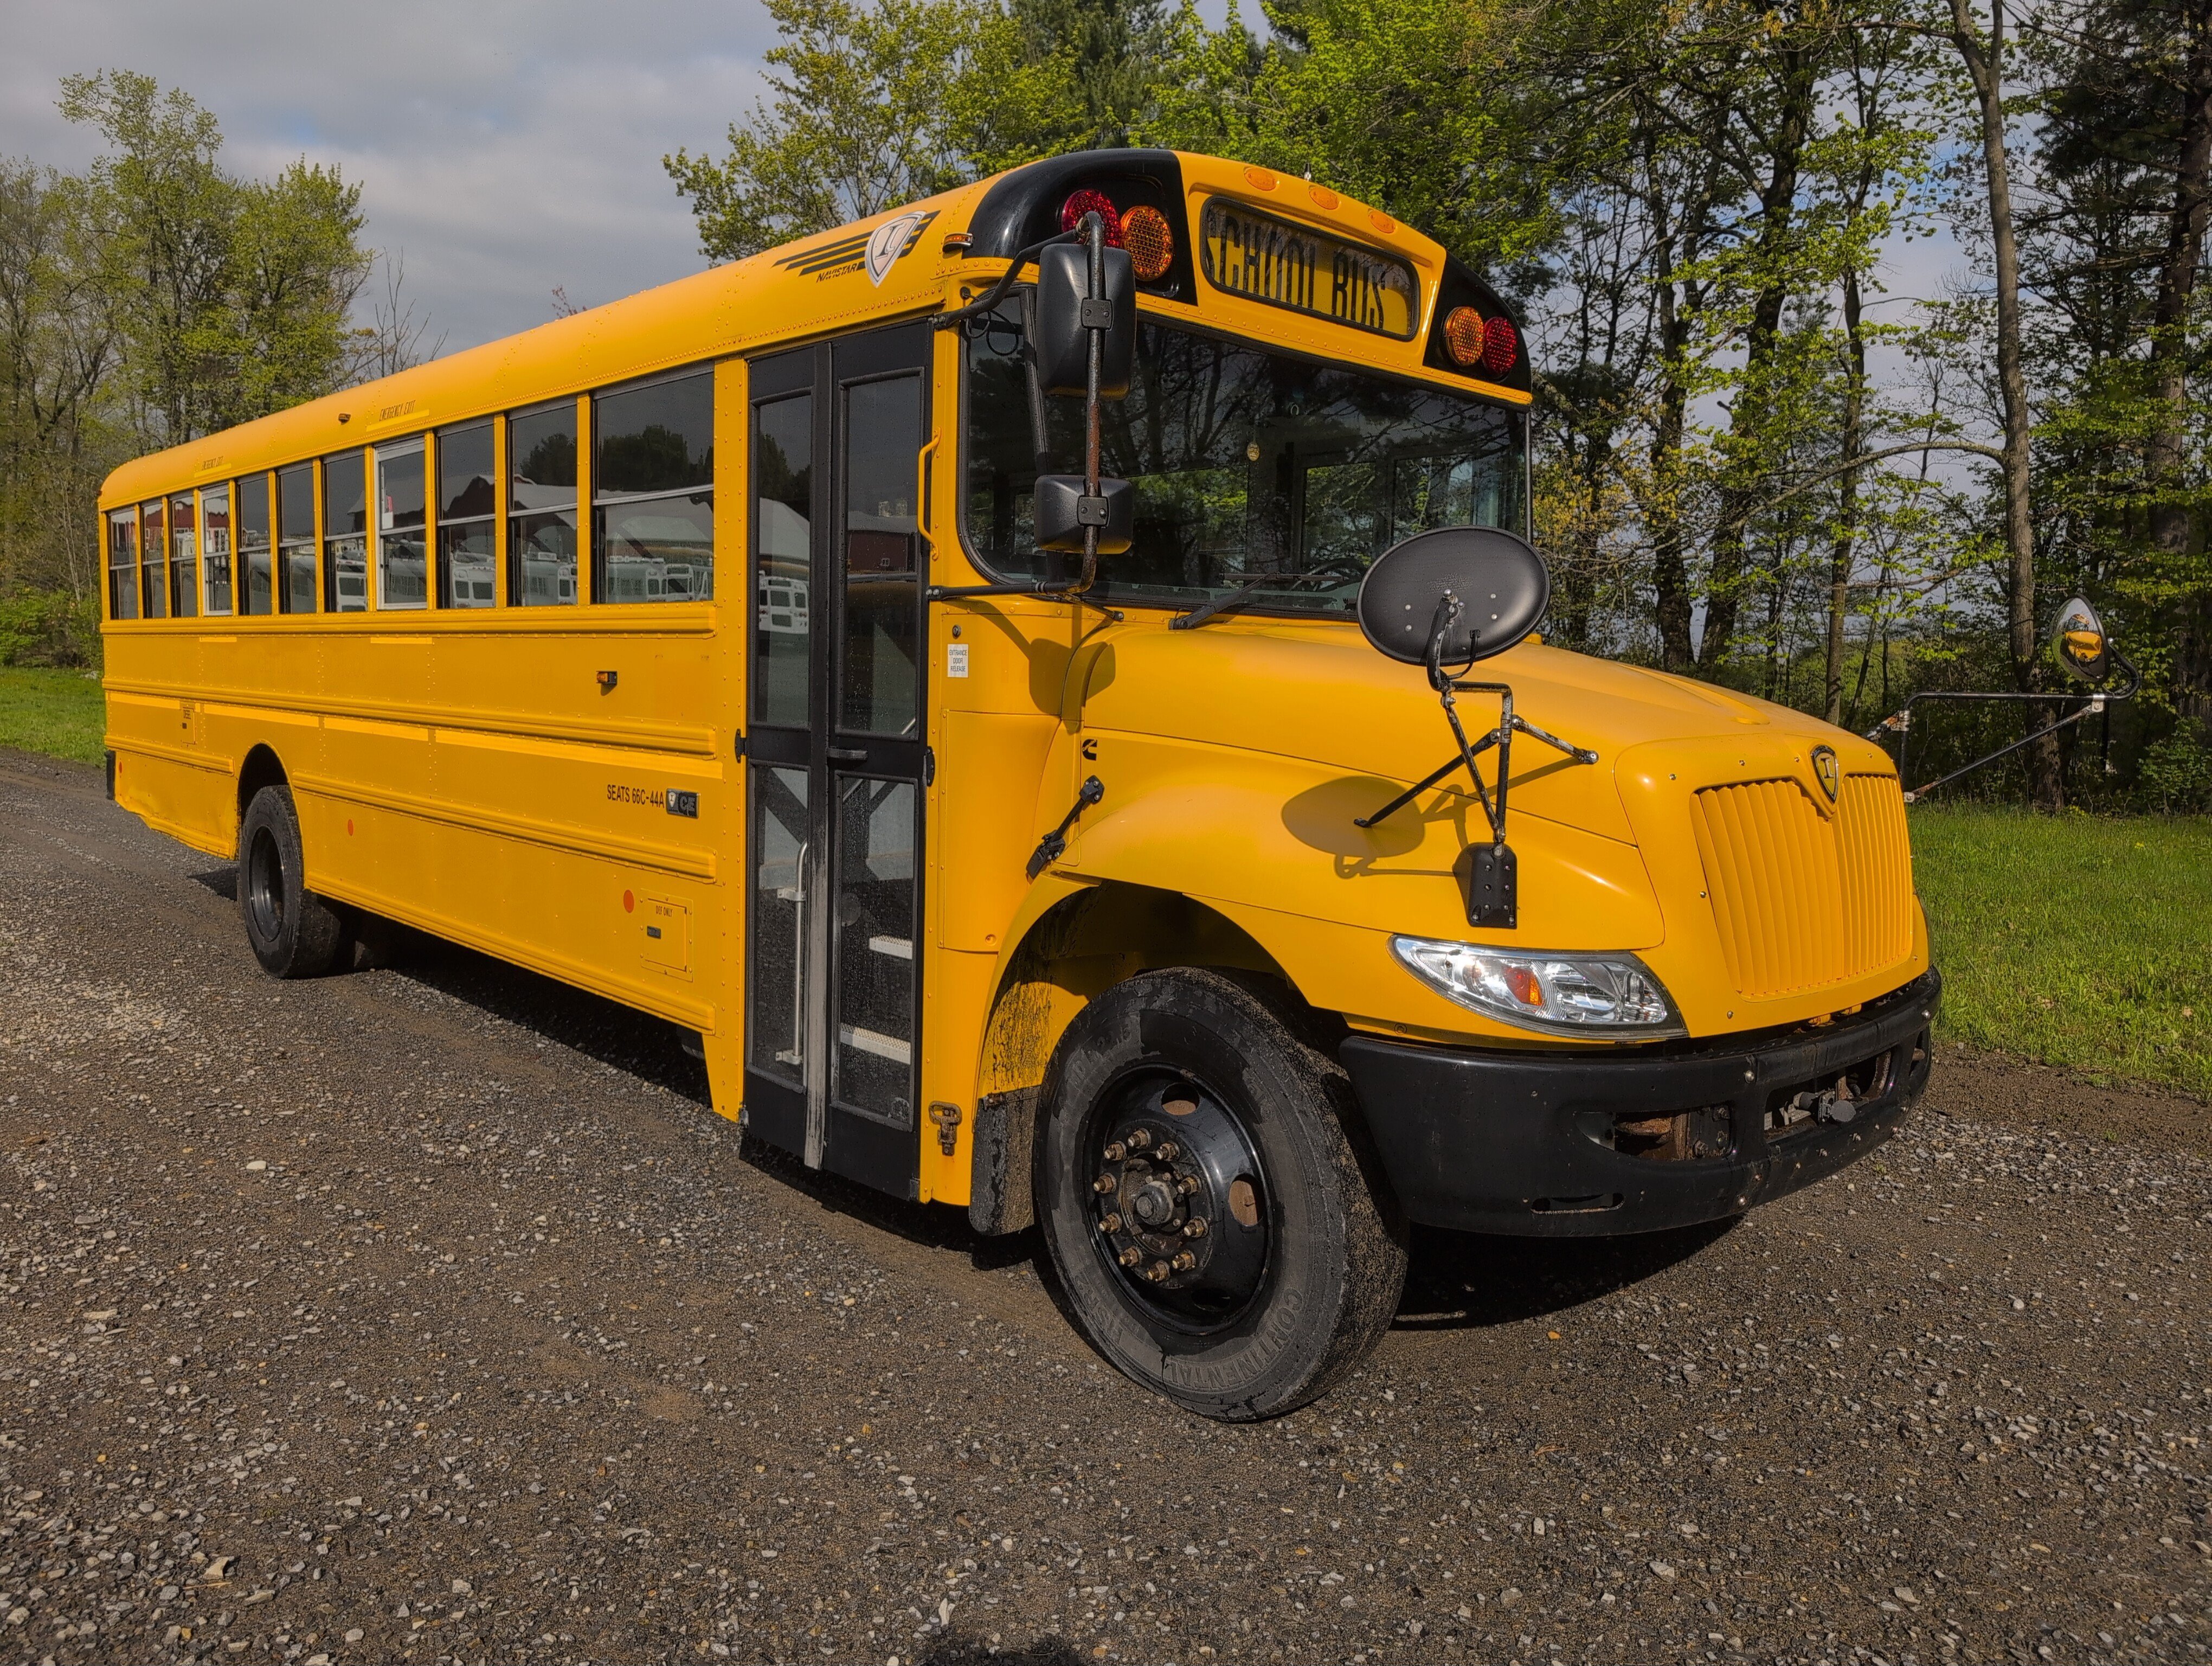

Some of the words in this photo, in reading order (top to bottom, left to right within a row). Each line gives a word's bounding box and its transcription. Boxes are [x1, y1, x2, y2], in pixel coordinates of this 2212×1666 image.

[816, 263, 859, 283] NAVISTAR
[1332, 251, 1385, 329] BUS
[607, 784, 630, 803] SEATS
[632, 788, 665, 809] 66C-44A
[663, 907, 673, 917] ONLY
[1165, 1287, 1303, 1389] CONTINENTAL
